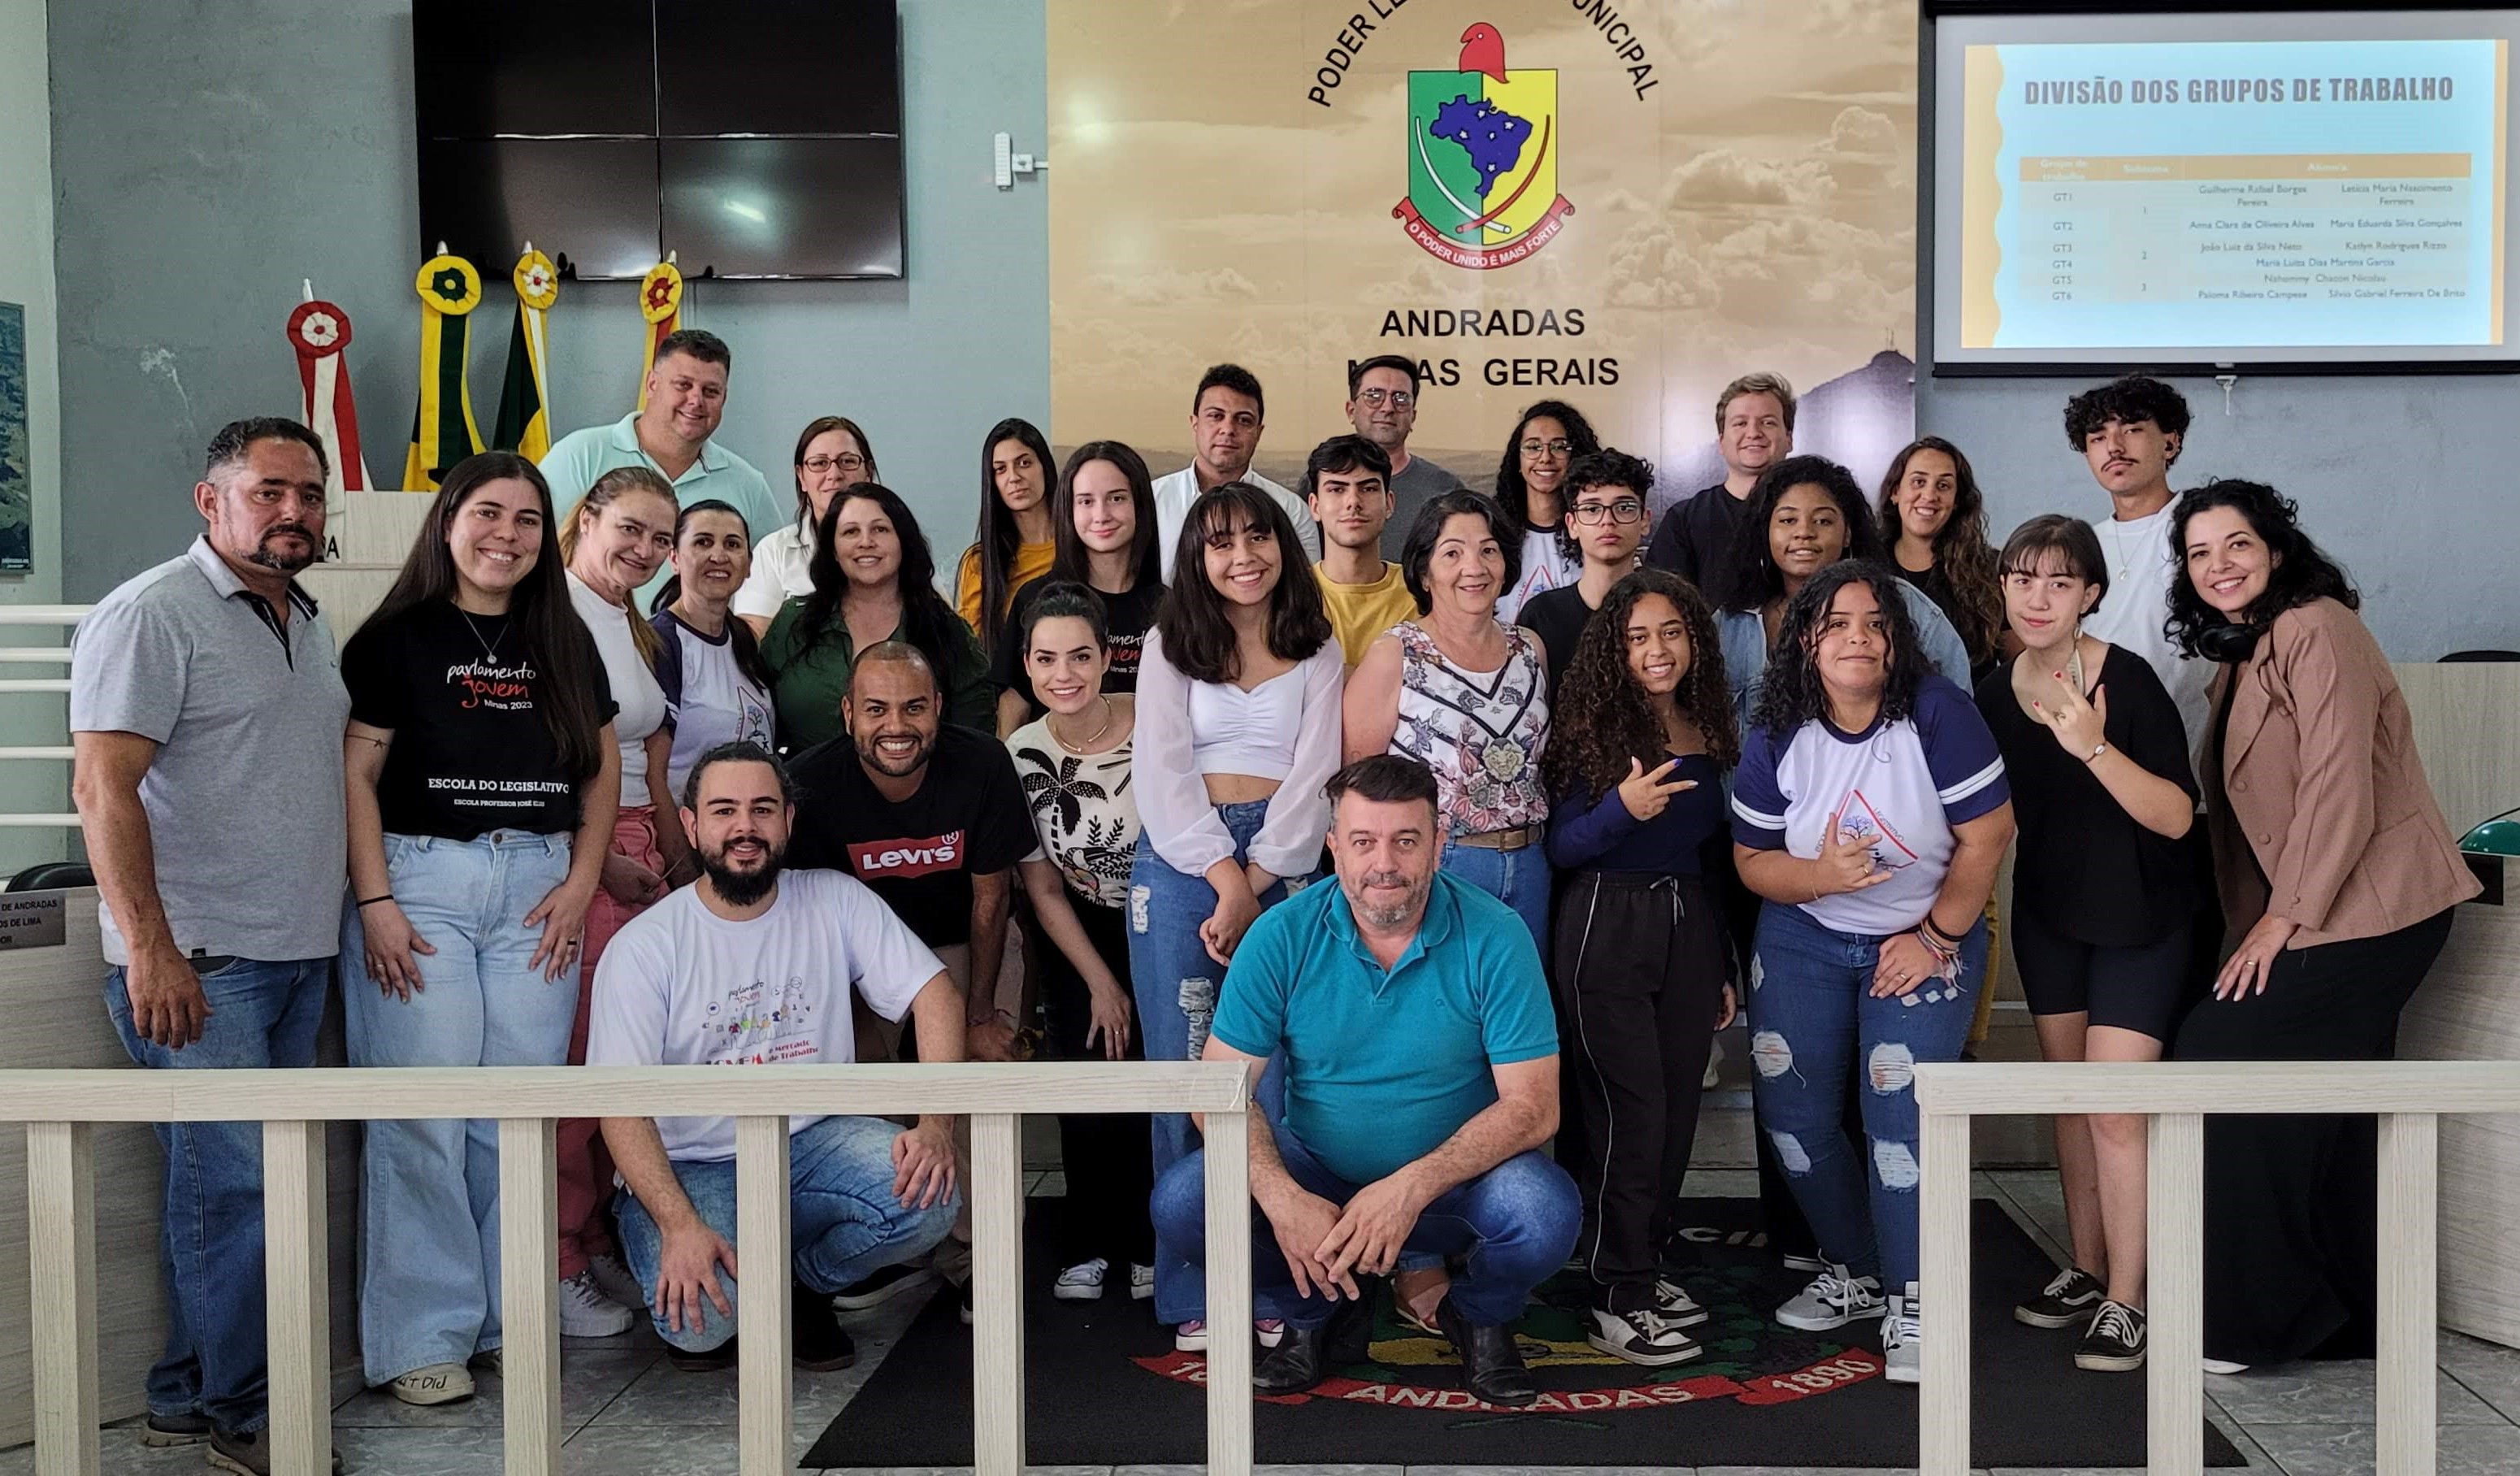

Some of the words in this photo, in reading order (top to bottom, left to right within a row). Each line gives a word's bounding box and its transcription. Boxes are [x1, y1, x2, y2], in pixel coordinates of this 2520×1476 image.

[1308, 14, 1377, 107] PODER
[1572, 0, 1659, 102] UNICIPAL
[2024, 76, 2123, 105] DIVISÃO
[2131, 80, 2180, 103] DOS
[2187, 78, 2285, 103] GRUPOS
[2292, 79, 2322, 102] DE
[2328, 76, 2453, 102] TRABALHO
[2198, 184, 2245, 194] Guilherme
[2248, 184, 2274, 193] Rafael
[2276, 184, 2307, 195] Borges
[2372, 184, 2397, 193] Maria
[2400, 184, 2453, 193] Nascimento
[2053, 221, 2073, 231] GT2
[2215, 219, 2238, 229] Clara
[2241, 219, 2252, 228] de
[2291, 219, 2314, 228] Alves
[2330, 219, 2354, 228] Maria
[2357, 219, 2392, 228] Eduarda
[2396, 219, 2414, 228] Silva
[1408, 223, 1421, 234] O
[1417, 231, 1451, 261] PODER
[1452, 254, 1488, 267] UNIDO
[1490, 255, 1499, 267] É
[1499, 245, 1528, 264] MAIS
[1527, 220, 1561, 252] FORTE
[2052, 244, 2072, 253] GT3
[2257, 241, 2276, 251] Silva
[2279, 242, 2302, 251] Neto
[2375, 241, 2420, 252] Rodrigues
[2141, 251, 2148, 260] 2
[2052, 260, 2072, 269] GT4
[2256, 258, 2280, 267] Maria
[2052, 276, 2072, 284] GT5
[2052, 291, 2072, 301] GT6
[2198, 290, 2229, 299] Paloma
[2232, 289, 2264, 299] Ribeiro
[2354, 289, 2387, 298] Gabriel
[2443, 288, 2466, 297] Brito
[1380, 308, 1585, 337] ANDRADAS
[1483, 357, 1620, 386] GERAIS
[446, 658, 536, 684] parlamento
[461, 672, 528, 709] jovem
[484, 698, 508, 710] Minas
[510, 701, 533, 710] 2023
[427, 778, 477, 790] ESCOLA
[479, 779, 498, 791] DO
[500, 781, 569, 793] LEGISLATIVO
[453, 798, 479, 806] ESCOLA
[2, 903, 12, 911] DE
[14, 899, 58, 910] ANDRADAS
[10, 918, 21, 927] DE
[23, 916, 41, 927] LIMA
[0, 936, 13, 944] OR
[1772, 1359, 1876, 1394] 1890
[1342, 1384, 1697, 1411] ANDADAS
